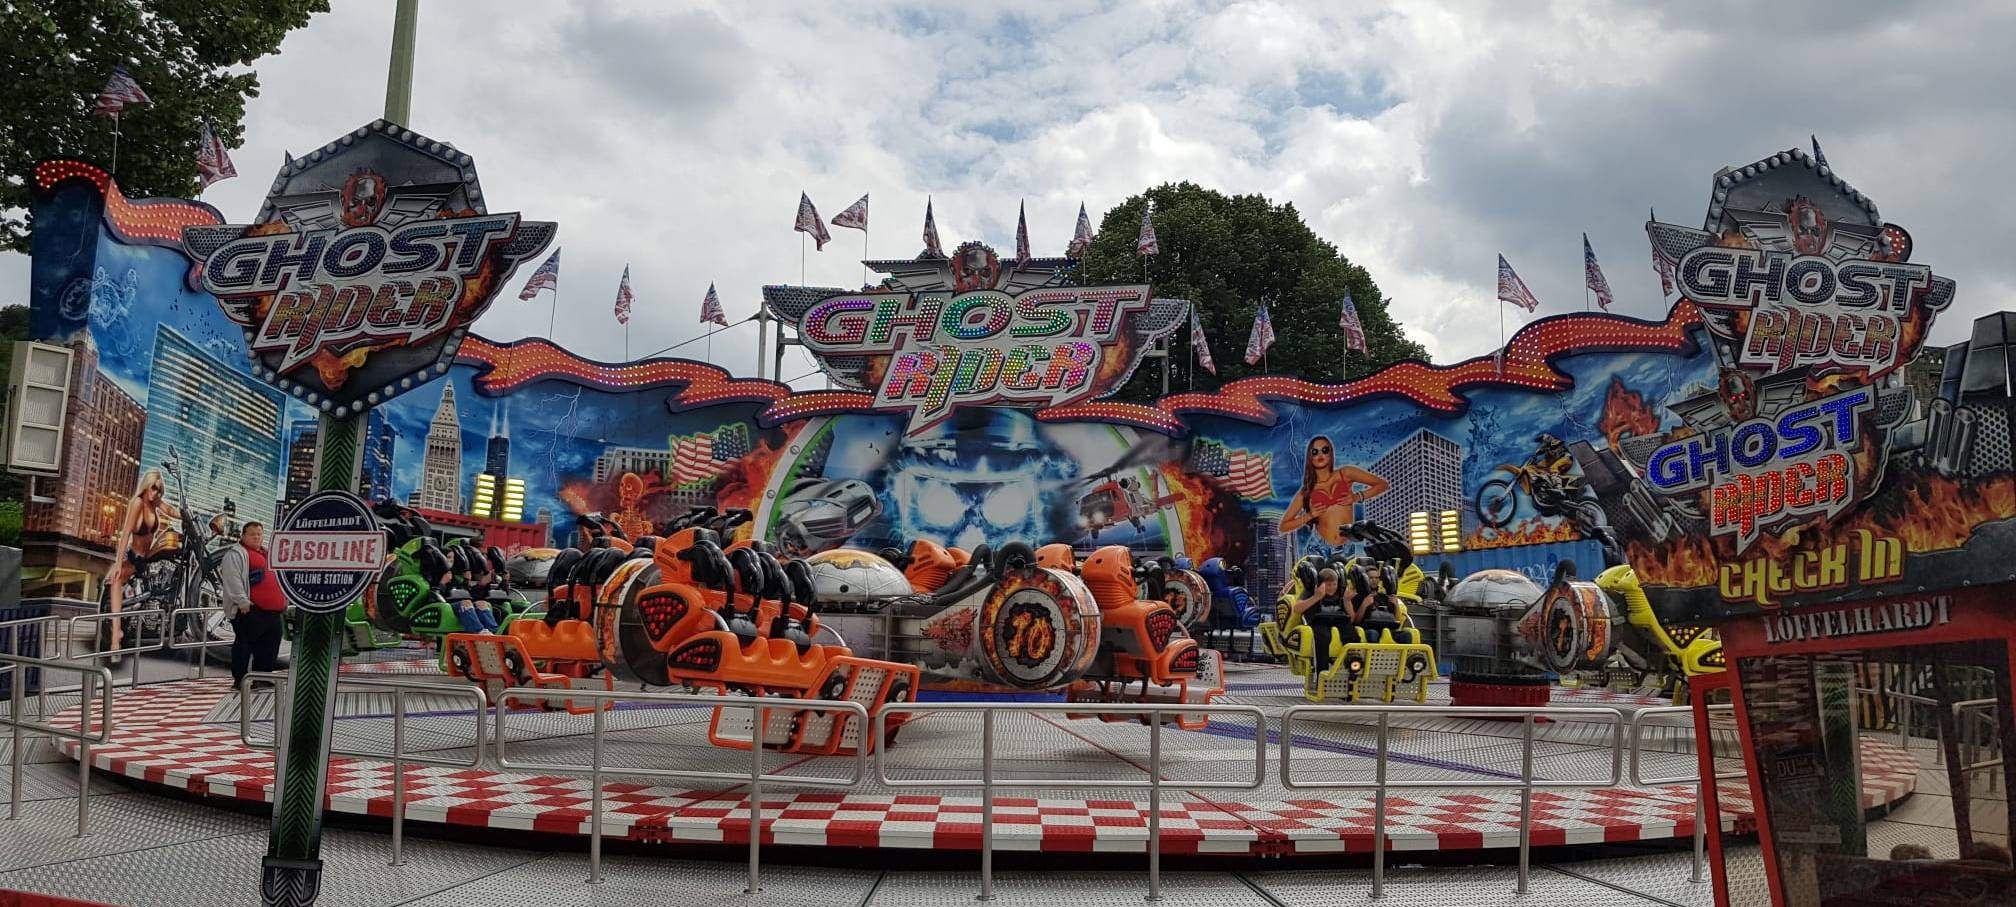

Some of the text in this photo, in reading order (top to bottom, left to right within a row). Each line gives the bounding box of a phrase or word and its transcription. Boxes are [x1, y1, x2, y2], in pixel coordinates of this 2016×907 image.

[206, 218, 508, 287] GHOST
[1682, 250, 1922, 310] GHOST
[264, 276, 455, 354] RIDER
[804, 289, 1140, 344] GHOST
[1749, 306, 1898, 373] RIDER
[884, 341, 1094, 414] RIDER
[1648, 391, 1867, 489] GHOST
[295, 515, 362, 529] LÖFFELHARDT
[1712, 453, 1848, 539] RIDER
[277, 538, 377, 564] GASOLINE
[294, 573, 354, 585] FILLING STATION
[1719, 544, 1848, 606] CHECK
[1761, 595, 1953, 644] LÖFFELHARDT
